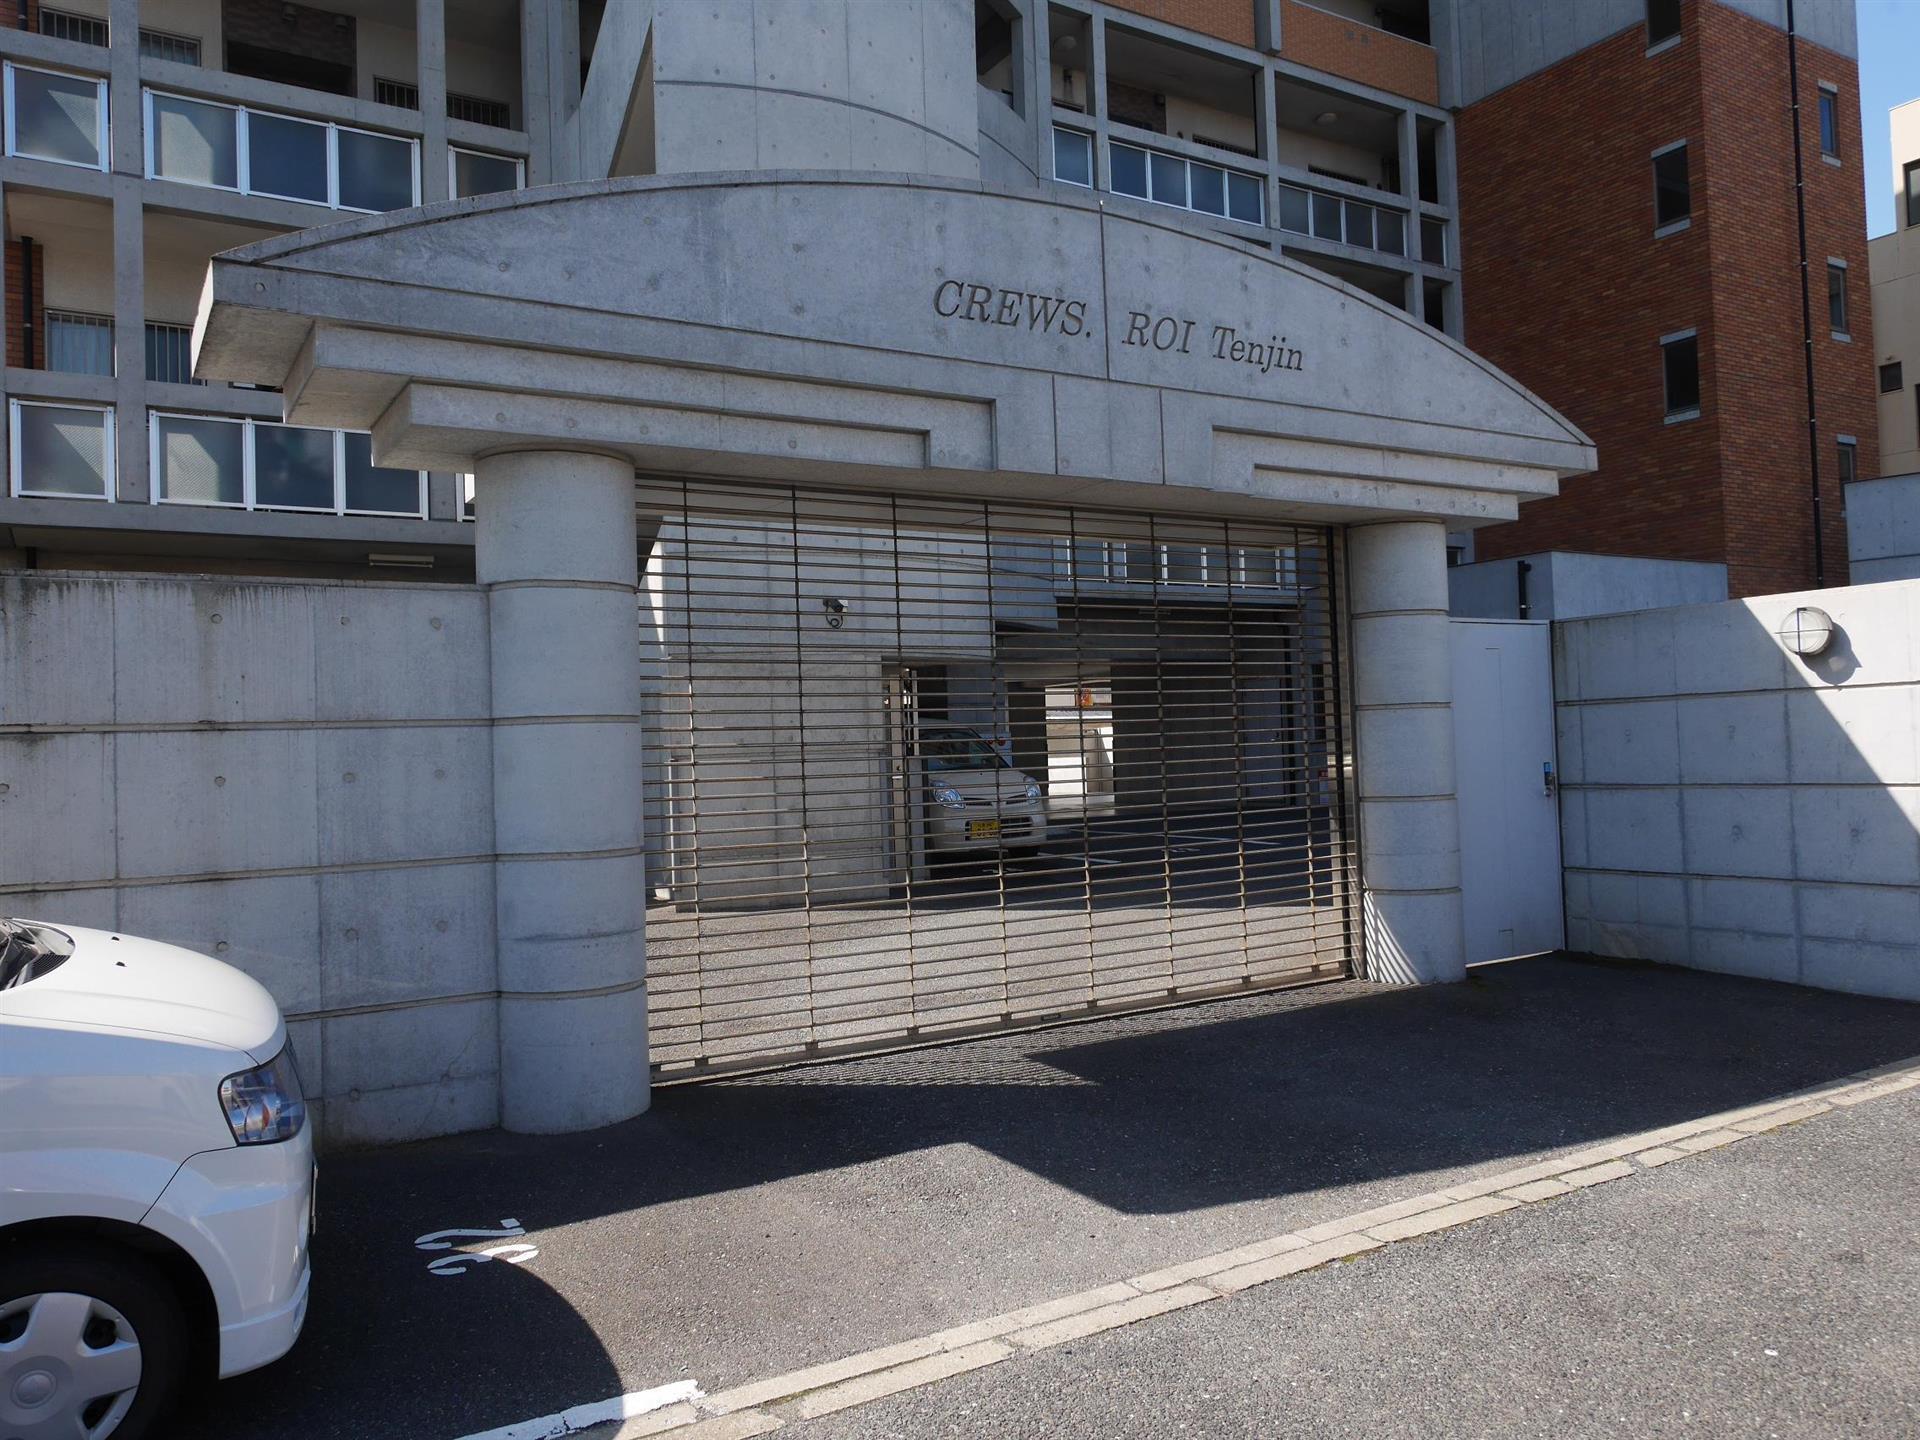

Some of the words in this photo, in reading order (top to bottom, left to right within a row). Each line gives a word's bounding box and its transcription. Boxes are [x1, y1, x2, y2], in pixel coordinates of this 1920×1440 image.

[934, 279, 1091, 338] CREWS.
[1121, 311, 1196, 354] ROI
[1212, 325, 1304, 374] Tenjin
[414, 1218, 540, 1276] 32
